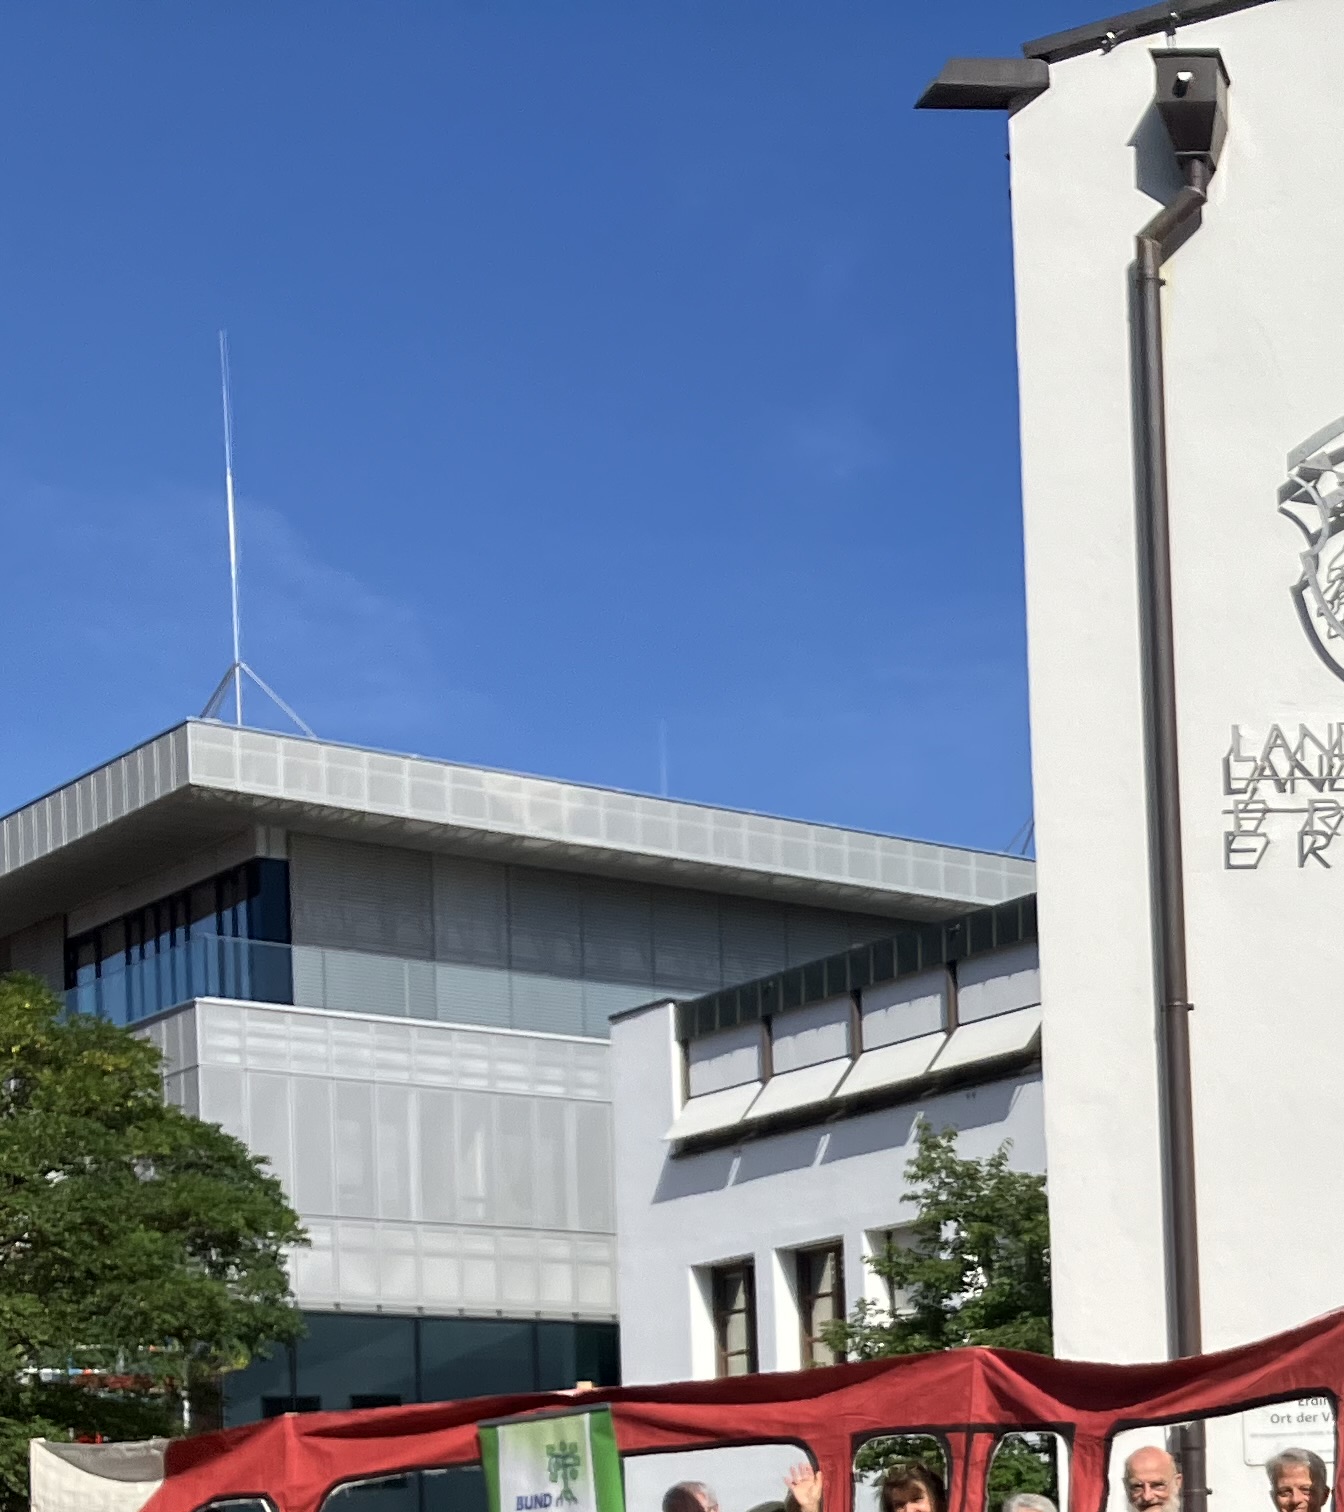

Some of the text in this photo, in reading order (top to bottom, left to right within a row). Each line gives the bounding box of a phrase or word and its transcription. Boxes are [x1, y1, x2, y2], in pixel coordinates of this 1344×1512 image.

[1270, 1412, 1292, 1424] Ort
[1296, 1411, 1318, 1423] der
[516, 1492, 553, 1512] BUND
